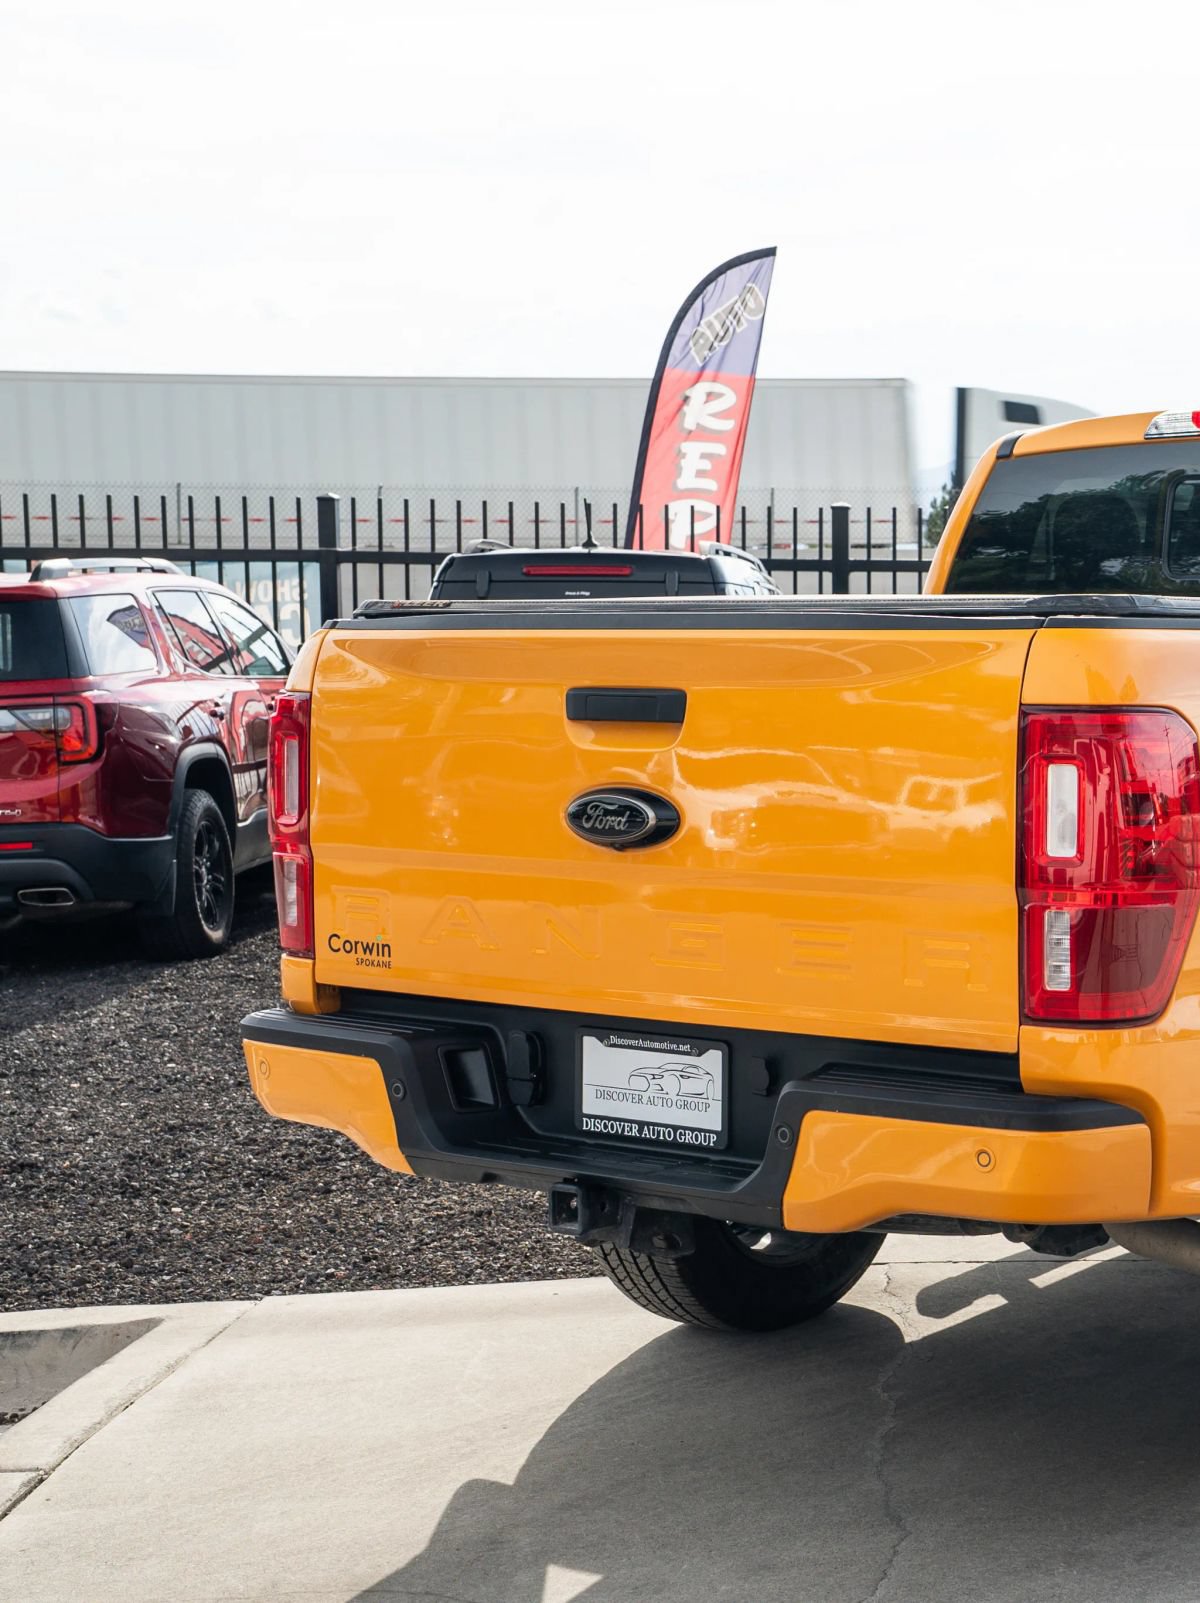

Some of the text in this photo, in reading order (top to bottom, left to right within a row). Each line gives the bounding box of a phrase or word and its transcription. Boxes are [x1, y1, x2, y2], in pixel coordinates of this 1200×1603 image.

[690, 282, 765, 366] AUTO
[582, 802, 630, 830] Ford
[328, 934, 391, 958] Corwin
[330, 886, 993, 992] RANGER
[356, 957, 392, 969] SPOKANE
[610, 1035, 691, 1052] DiscoverAutomotive.net
[595, 1088, 711, 1113] DISCOVER AUTO GROUP
[582, 1117, 717, 1146] DISCOVER AUTO GROUP
